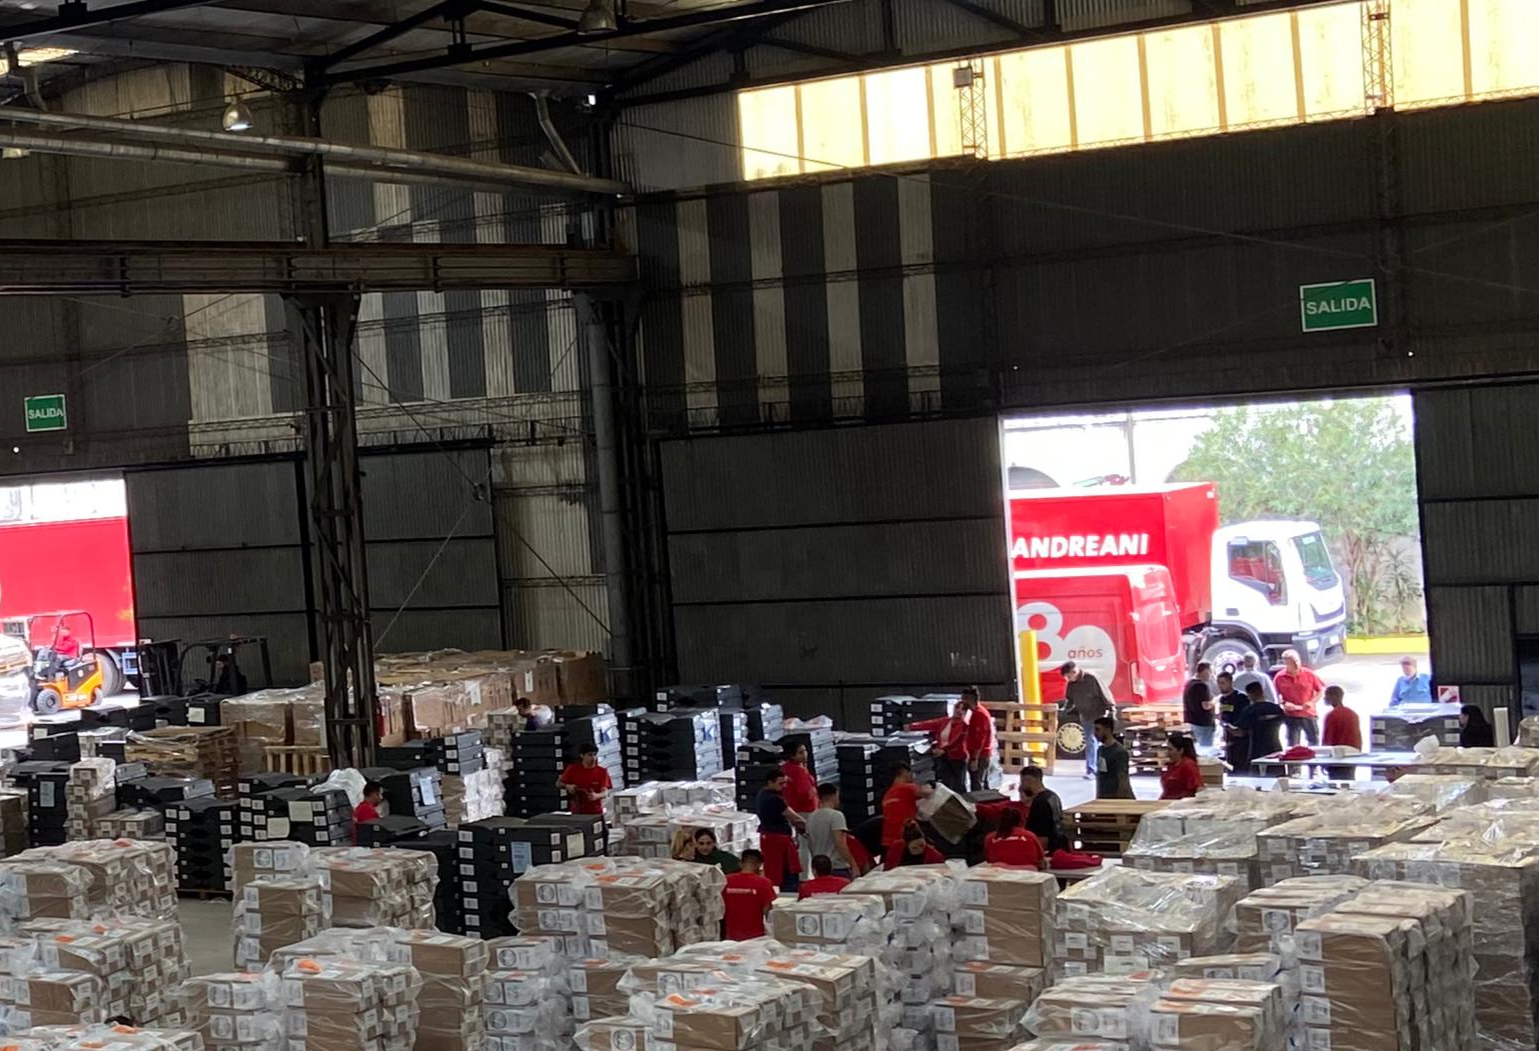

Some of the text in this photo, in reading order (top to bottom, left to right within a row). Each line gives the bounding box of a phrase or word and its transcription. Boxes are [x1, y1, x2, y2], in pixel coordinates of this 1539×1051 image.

[1306, 296, 1372, 315] SALIDA
[28, 408, 64, 420] SALIDA
[1011, 533, 1148, 559] ANDREANI
[1067, 645, 1103, 660] años
